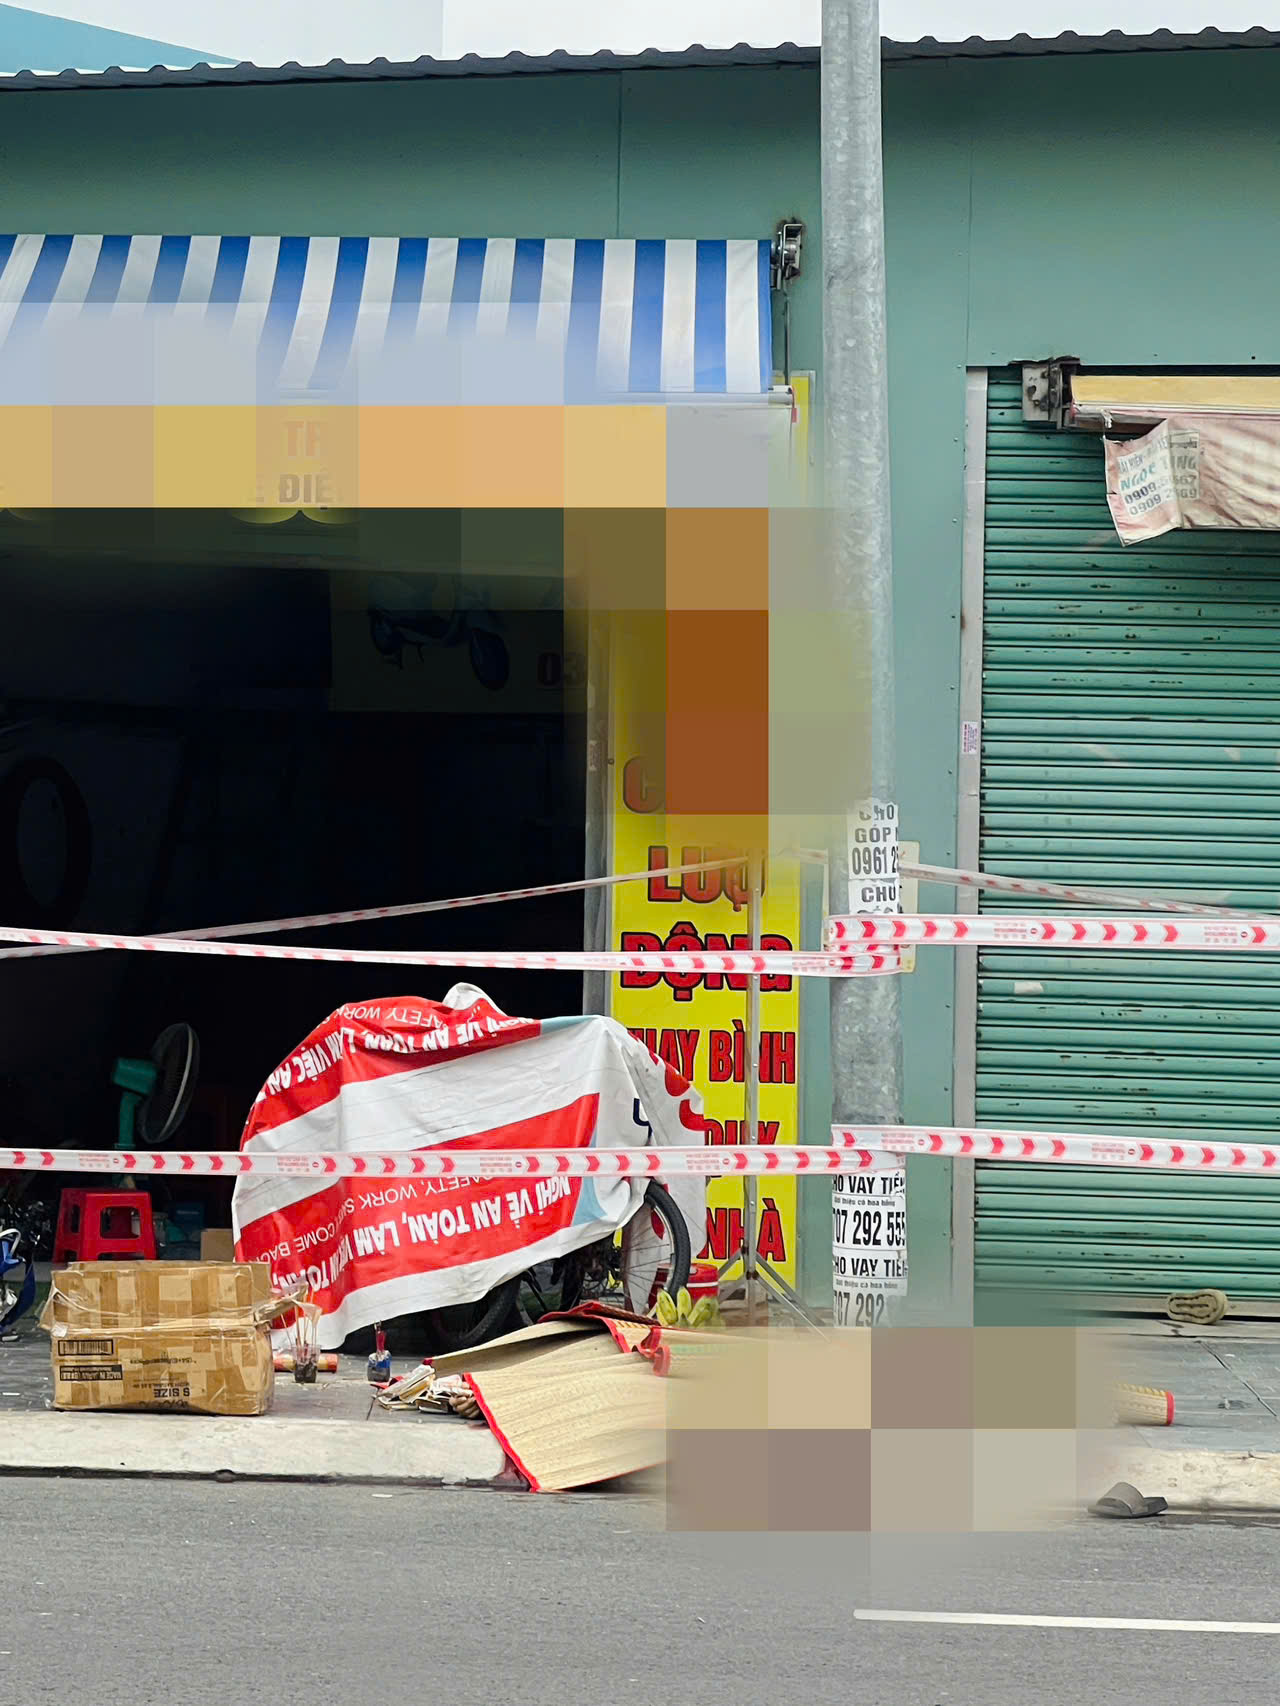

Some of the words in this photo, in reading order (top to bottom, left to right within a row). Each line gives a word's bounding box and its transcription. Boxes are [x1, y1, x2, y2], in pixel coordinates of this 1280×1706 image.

[851, 846, 888, 876] 0961
[420, 1025, 449, 1052] AN
[359, 1183, 418, 1210] WORK
[848, 1175, 876, 1195] VAY
[401, 1204, 470, 1244] TOÀN,
[471, 1196, 503, 1231] AN
[852, 1210, 882, 1246] 292
[352, 1219, 401, 1258] LÀM
[696, 1198, 786, 1262] NHÀ
[851, 1257, 878, 1277] VAY
[855, 1293, 885, 1327] 292
[153, 1387, 180, 1398] SIZE
